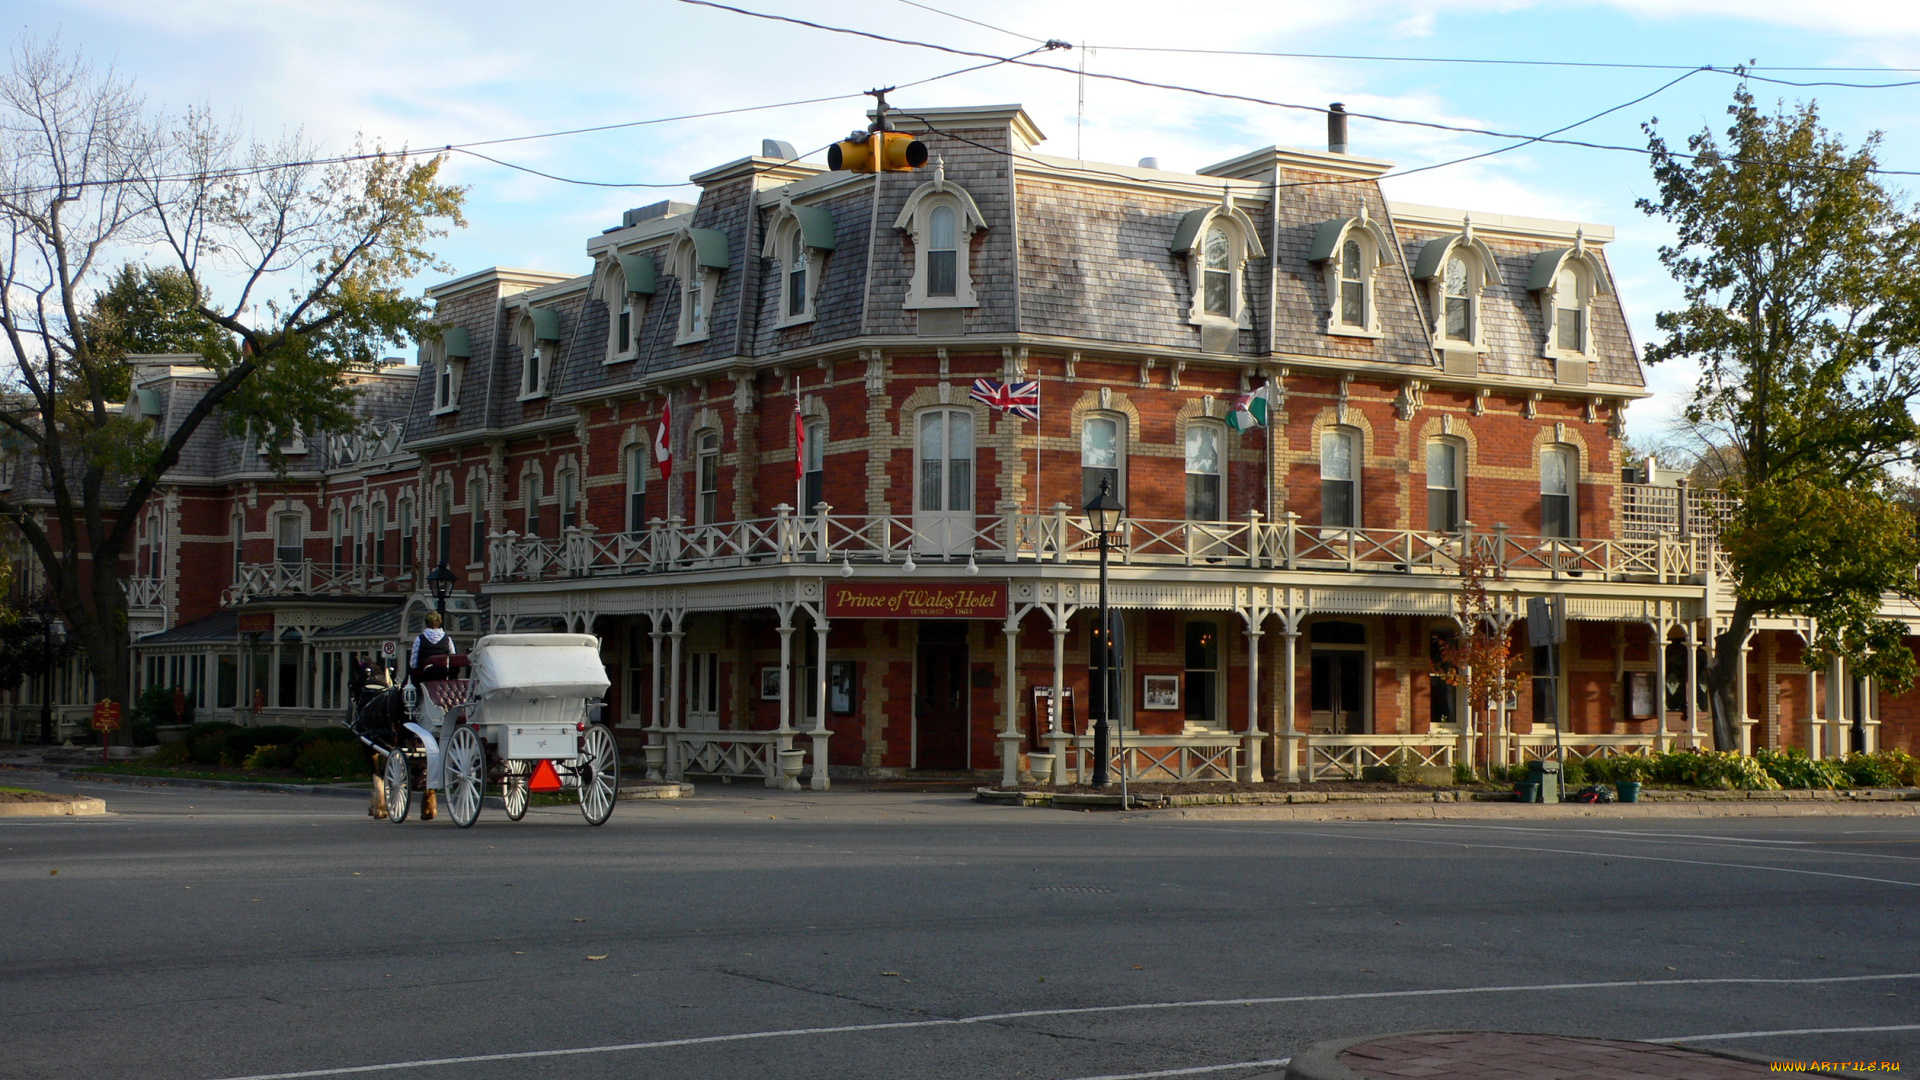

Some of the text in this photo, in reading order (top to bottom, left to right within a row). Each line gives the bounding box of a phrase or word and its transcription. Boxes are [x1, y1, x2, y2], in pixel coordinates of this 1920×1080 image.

[836, 590, 997, 611] Prince of Wales Hotel
